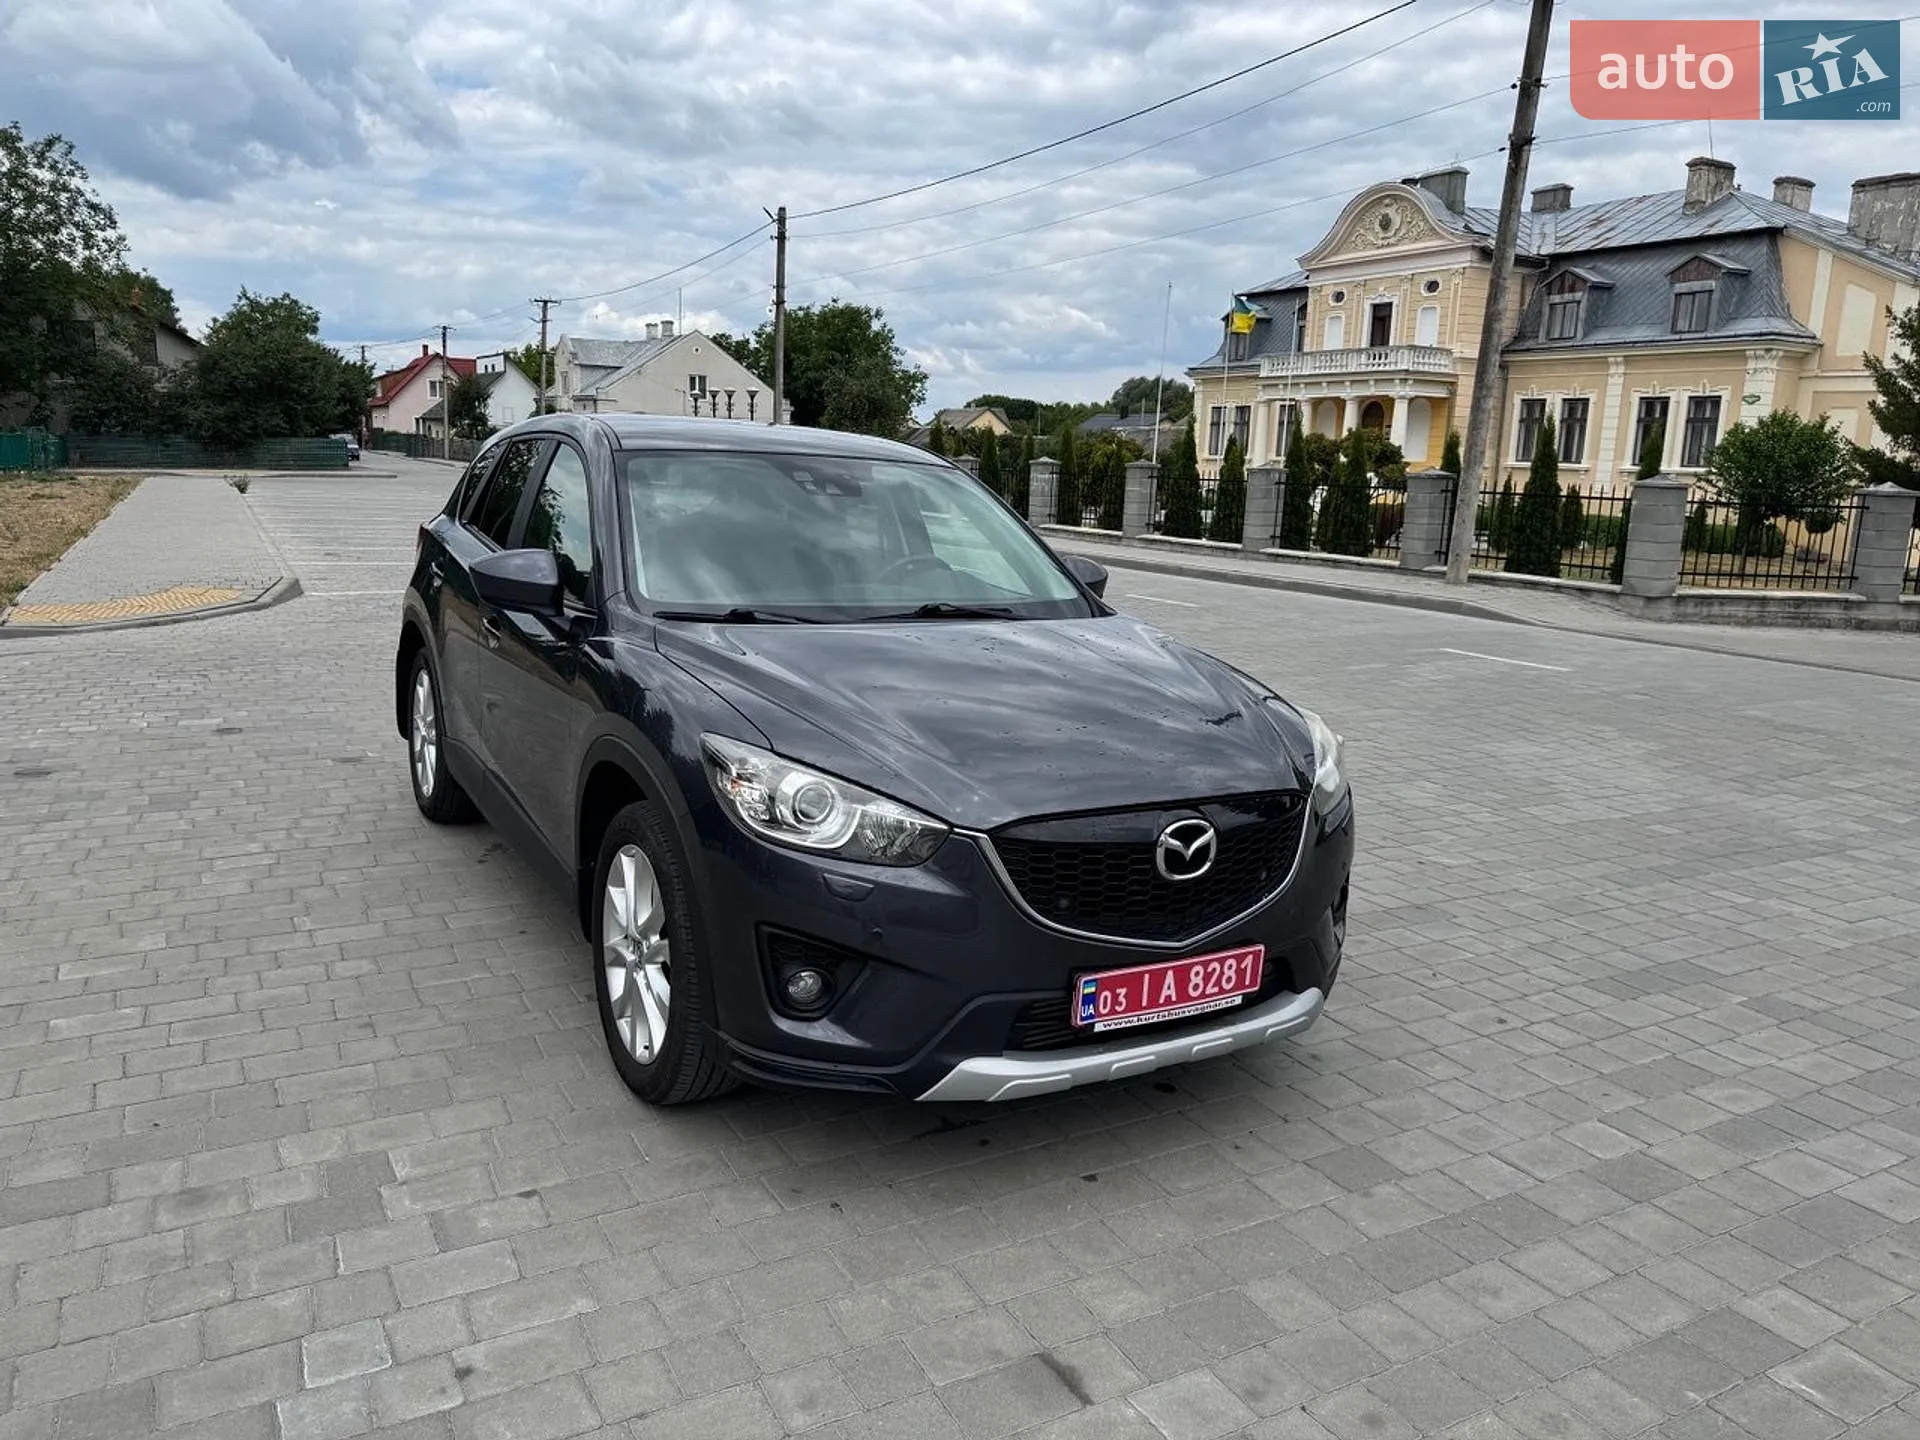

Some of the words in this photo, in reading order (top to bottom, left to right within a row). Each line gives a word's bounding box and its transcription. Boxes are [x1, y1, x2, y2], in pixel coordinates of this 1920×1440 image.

[1099, 987, 1127, 1015] 03
[1188, 954, 1254, 998] 8281
[1081, 1003, 1095, 1017] UA
